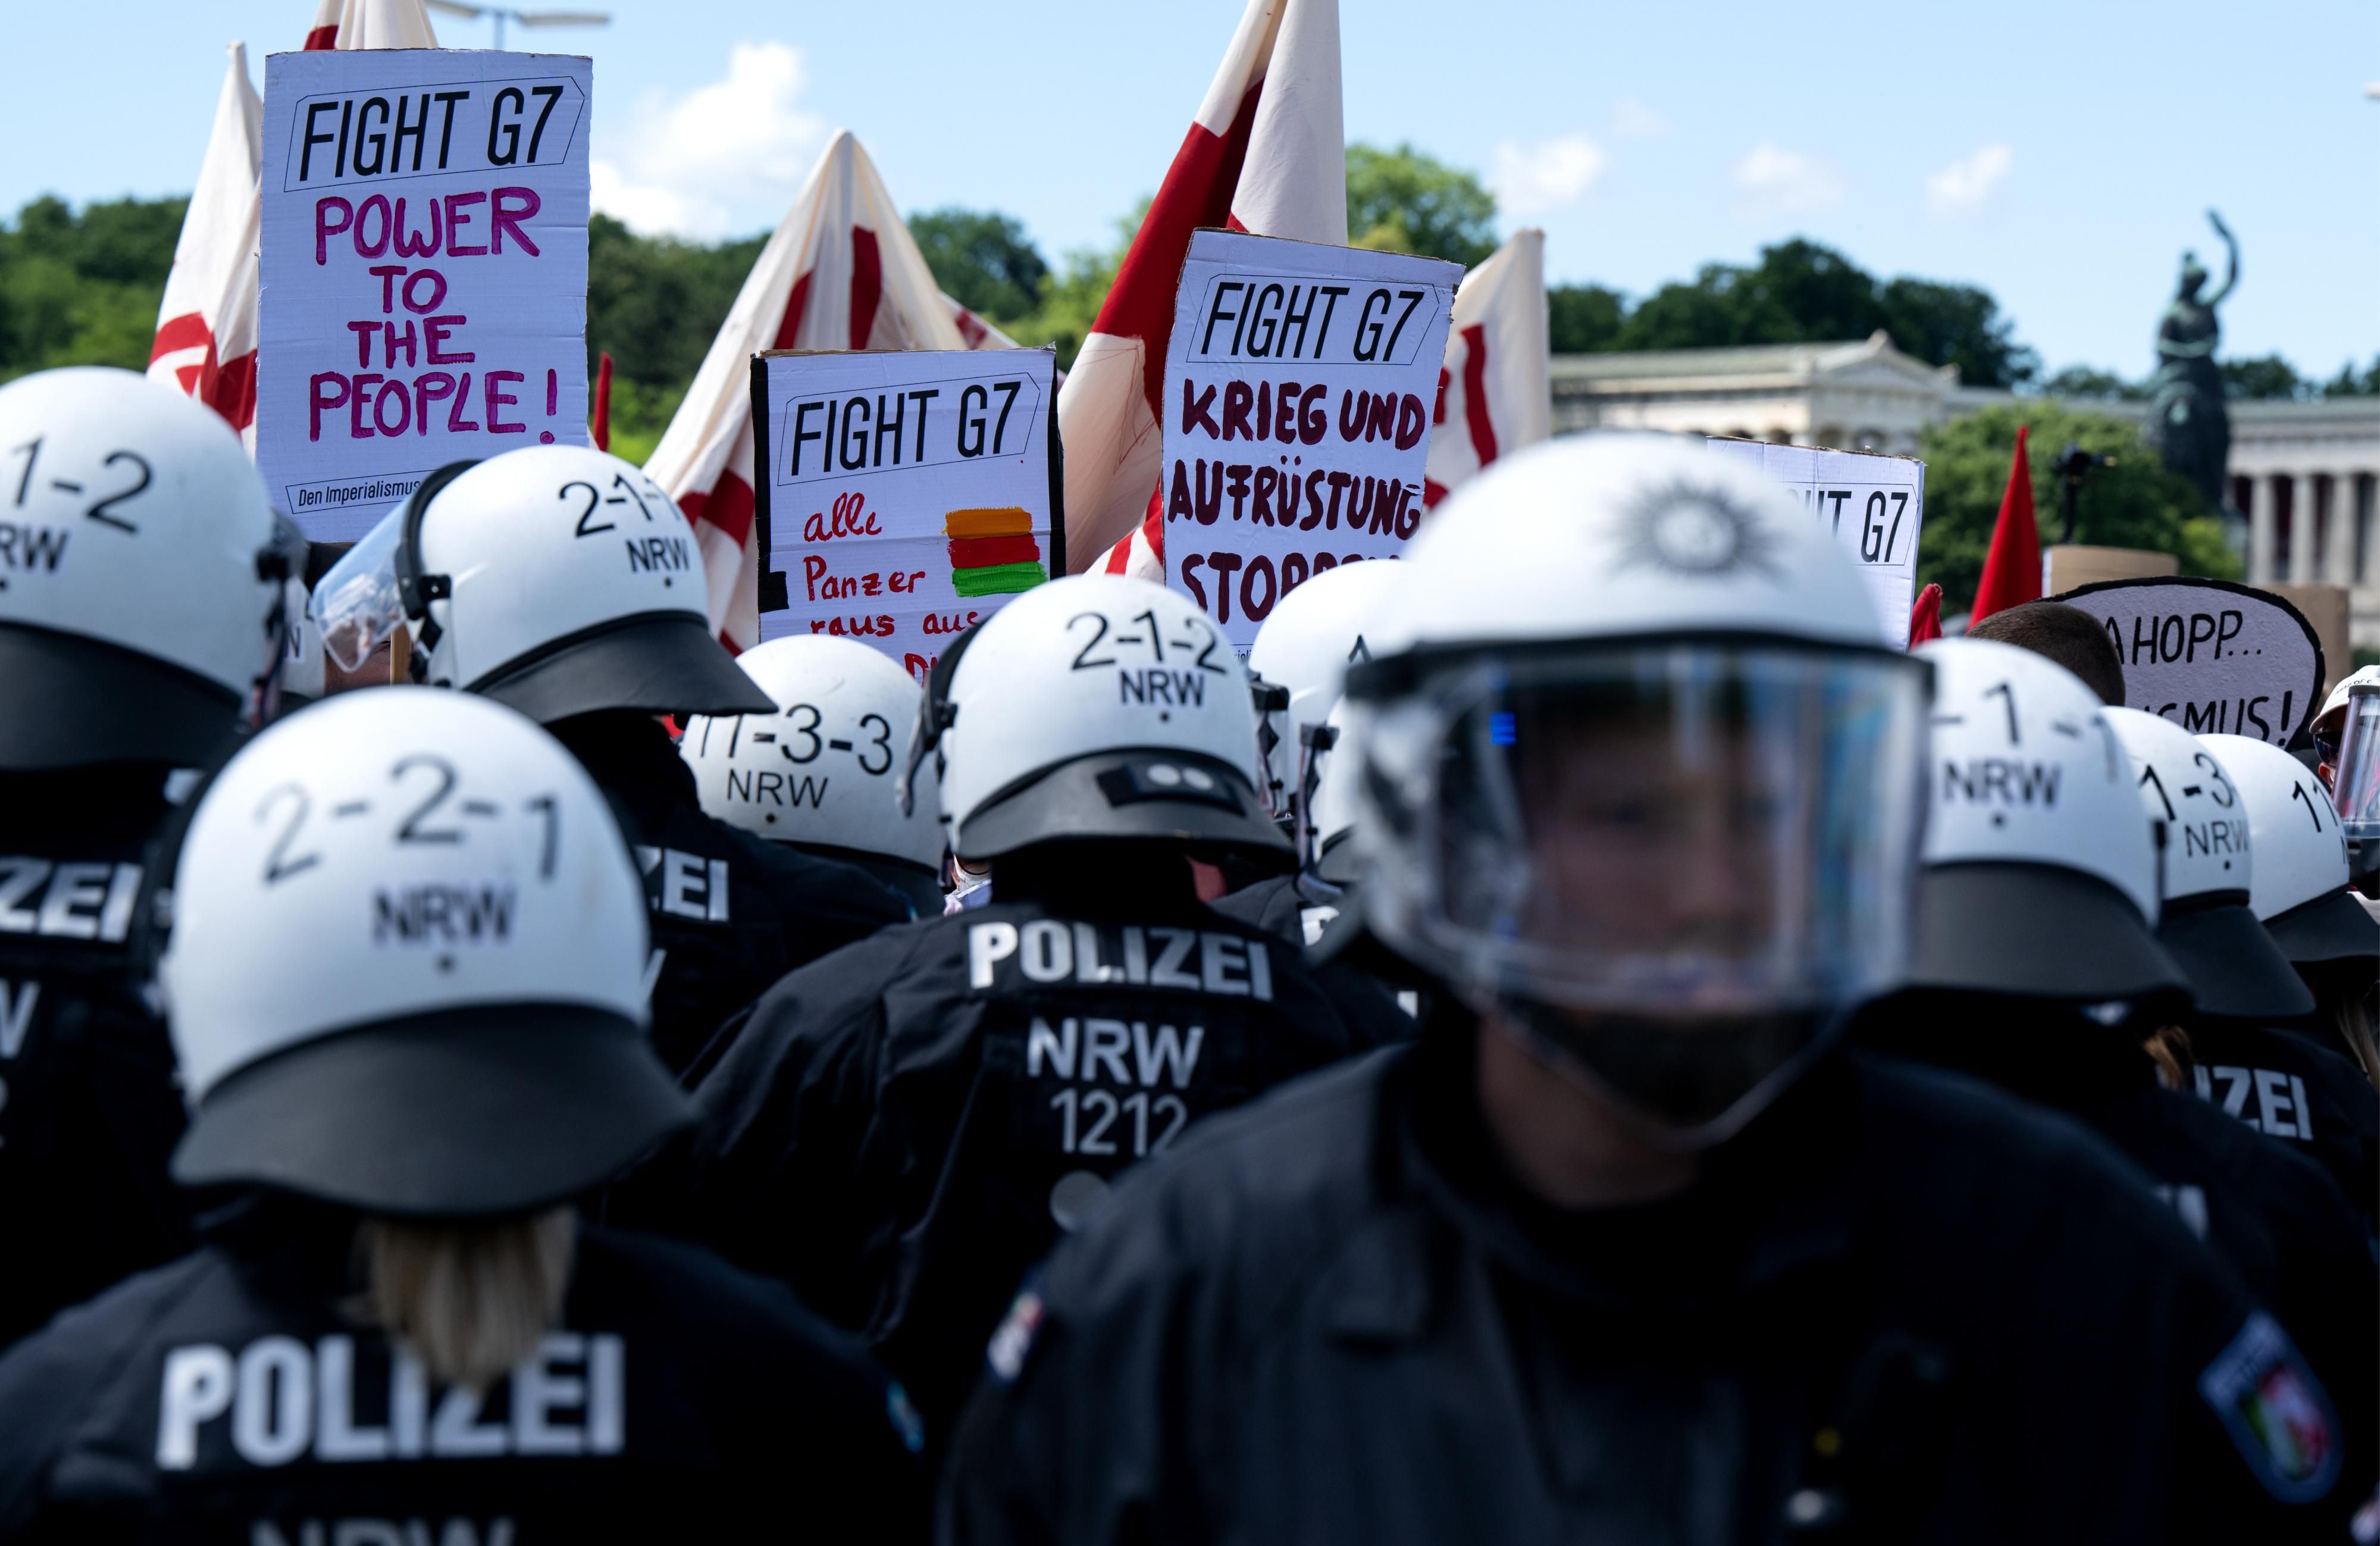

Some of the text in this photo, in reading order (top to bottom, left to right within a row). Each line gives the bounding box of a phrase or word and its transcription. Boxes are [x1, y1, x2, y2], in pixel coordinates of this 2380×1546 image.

[299, 86, 563, 181] FIGHT G7
[316, 187, 540, 265] POWER
[369, 265, 447, 314] TO
[1201, 281, 1424, 362] FIGHT G7
[347, 315, 475, 369] THE
[791, 381, 1022, 476] FIGHT G7
[1182, 378, 1426, 451] KRIEG UND
[299, 489, 322, 506] Den
[804, 492, 882, 543] alle
[1167, 455, 1422, 540] AUFRÜSTUNG
[1861, 490, 1908, 562] G7
[626, 537, 689, 572] NRW
[803, 555, 925, 602] Panzer
[810, 614, 895, 637] raus
[1066, 610, 1227, 675] 2-1-2
[2132, 610, 2262, 665] HOPP...
[1120, 669, 1205, 707] NRW
[728, 768, 828, 809] NRW
[1945, 760, 2062, 805] NRW
[252, 753, 558, 883] 2-2-1
[372, 883, 516, 947] NRW
[969, 919, 1274, 1002] POLIZEI
[1027, 1016, 1204, 1089] NRW
[1050, 1088, 1188, 1158] 1212
